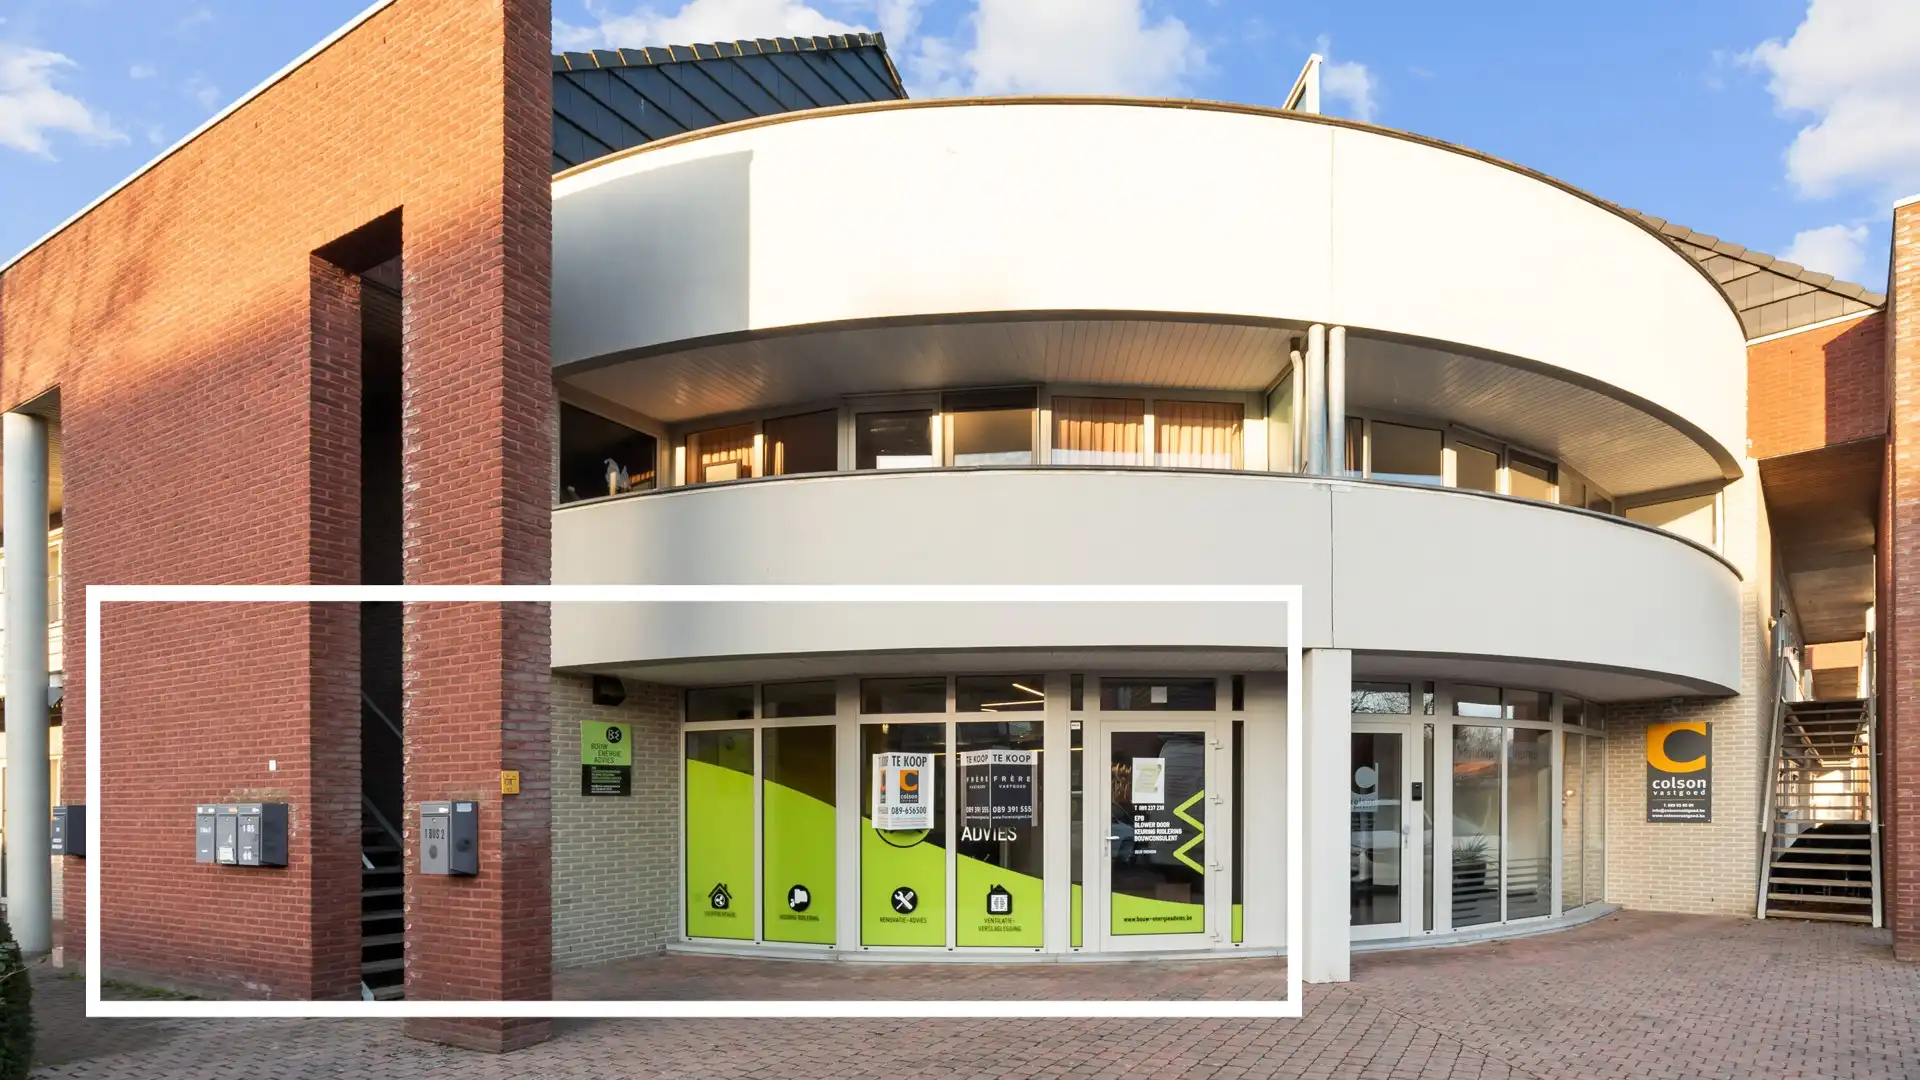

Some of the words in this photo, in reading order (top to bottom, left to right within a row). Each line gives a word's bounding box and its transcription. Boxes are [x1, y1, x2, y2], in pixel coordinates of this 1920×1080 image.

[892, 756, 901, 767] TE
[904, 756, 927, 767] KOOP
[993, 754, 1003, 763] TE
[1006, 755, 1031, 763] KOOP
[1652, 777, 1707, 789] colson
[891, 807, 927, 815] 089-656500
[429, 829, 440, 840] BUS
[961, 827, 1017, 841] ADVIES
